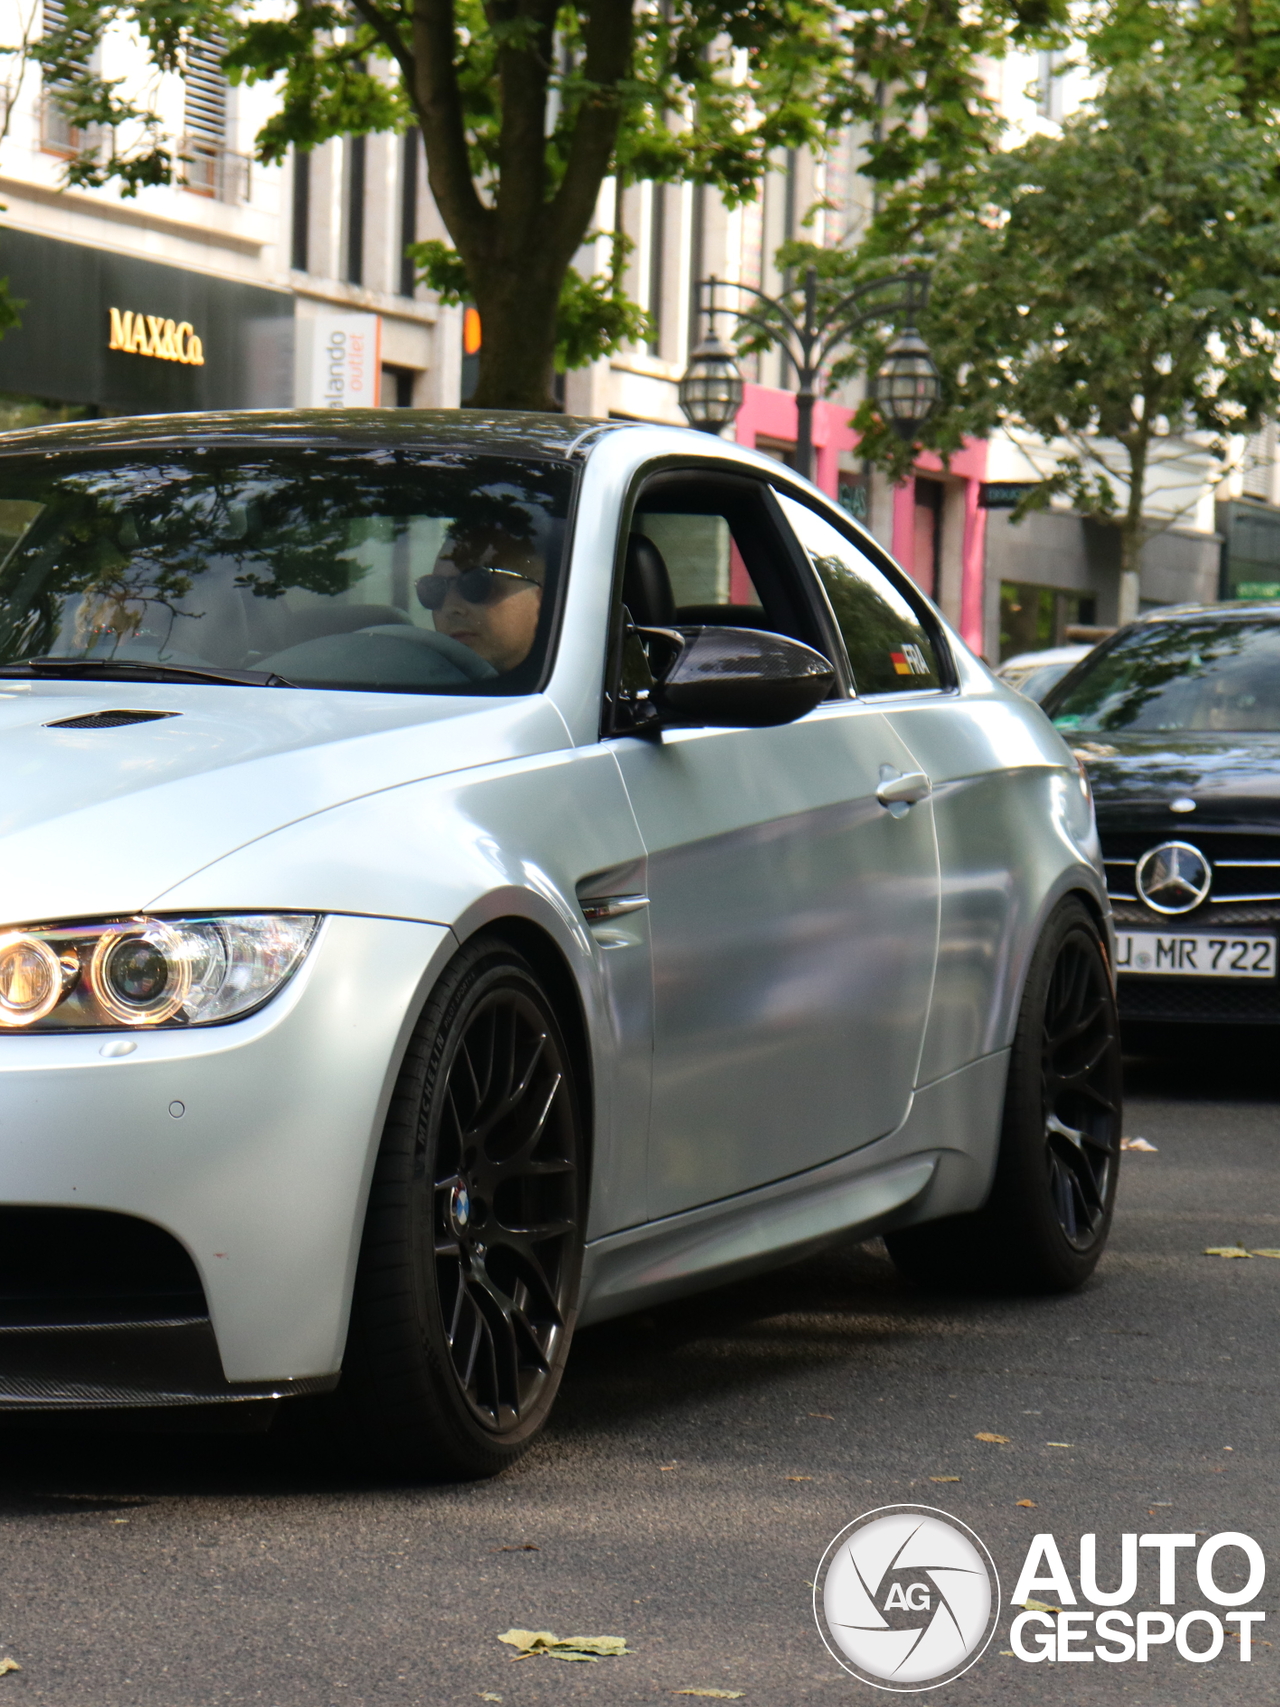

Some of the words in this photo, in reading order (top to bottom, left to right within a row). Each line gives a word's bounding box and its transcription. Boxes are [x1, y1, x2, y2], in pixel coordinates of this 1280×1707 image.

[109, 307, 205, 366] MAX&Co.
[349, 333, 364, 392] outlet
[324, 330, 346, 409] alando
[1157, 937, 1197, 969] MR
[1209, 939, 1271, 971] 722
[416, 1035, 446, 1147] MICHELIN
